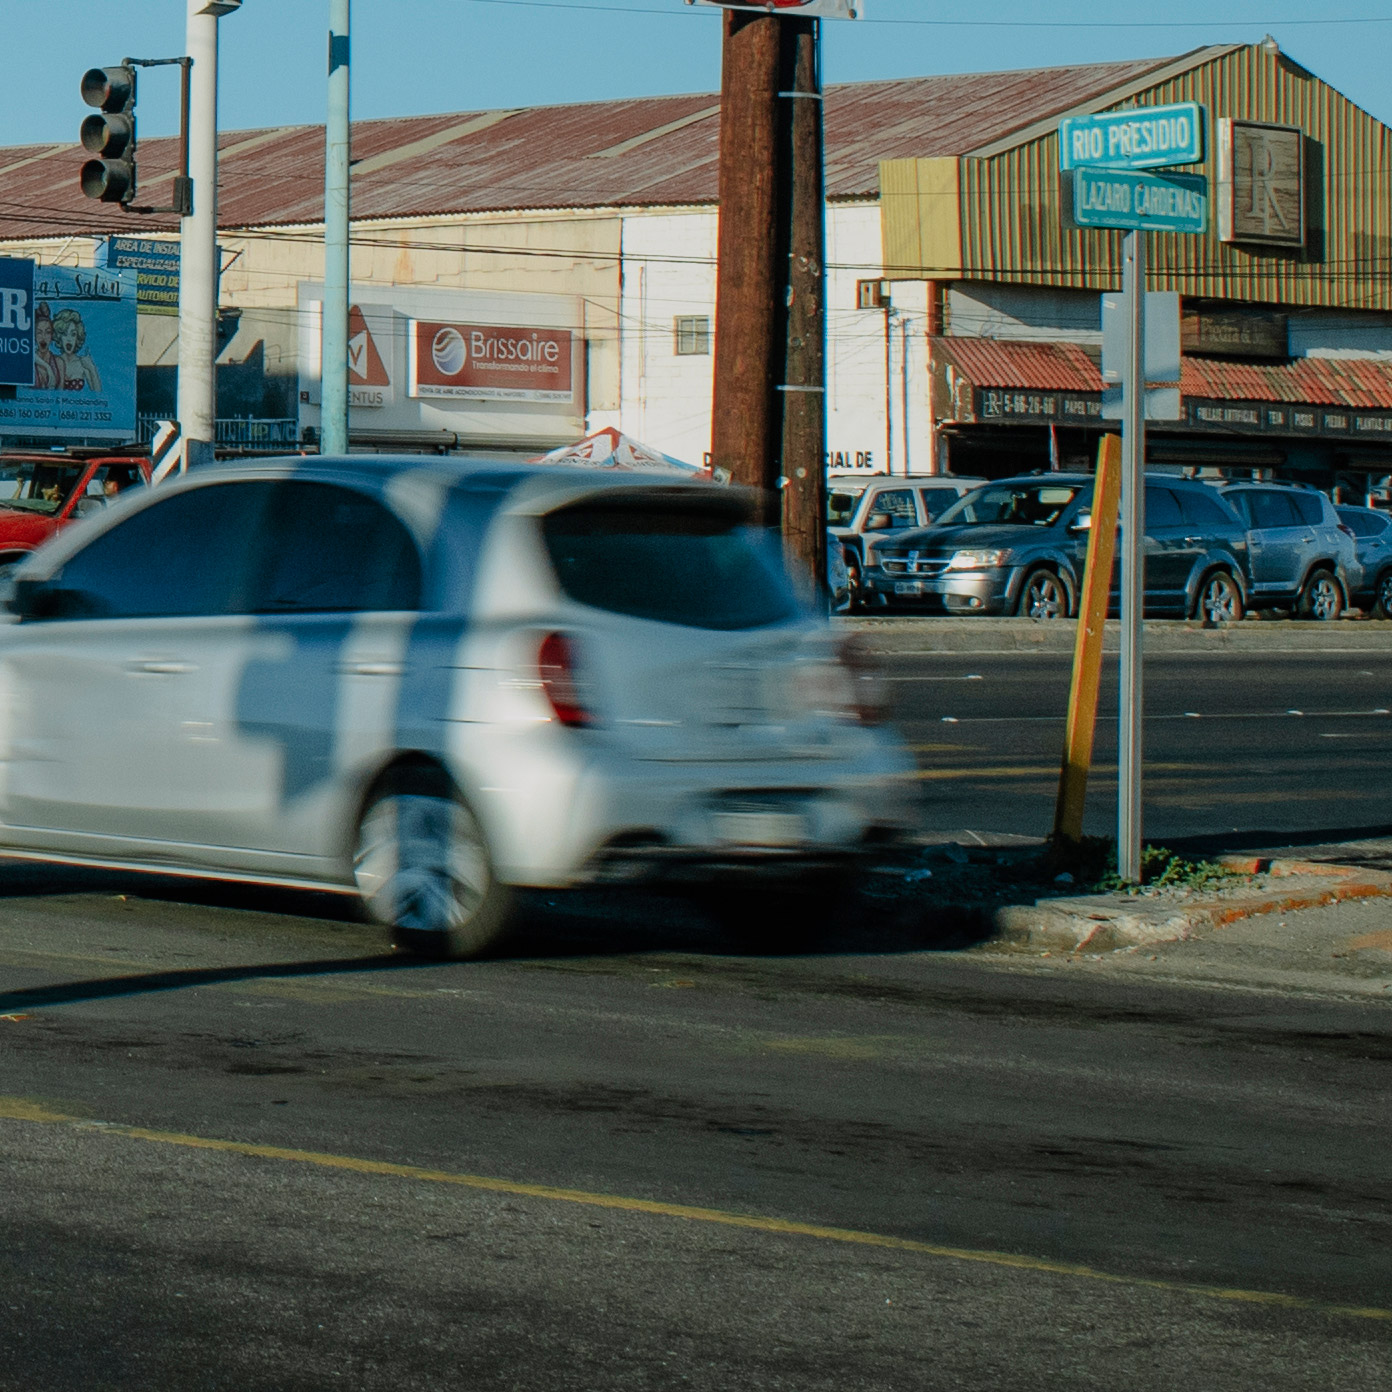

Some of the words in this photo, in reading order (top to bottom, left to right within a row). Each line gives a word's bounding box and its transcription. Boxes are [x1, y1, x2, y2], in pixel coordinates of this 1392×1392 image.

[1073, 127, 1104, 160] RIO
[1109, 116, 1189, 156] PRESIDIO
[1082, 179, 1131, 213] LAZARO
[1134, 182, 1201, 219] CARDENAS
[137, 273, 167, 286] RVICIO
[471, 330, 560, 362] Brissaire
[472, 360, 529, 372] Transformando
[348, 391, 383, 405] ENTUS
[856, 451, 873, 468] DE
